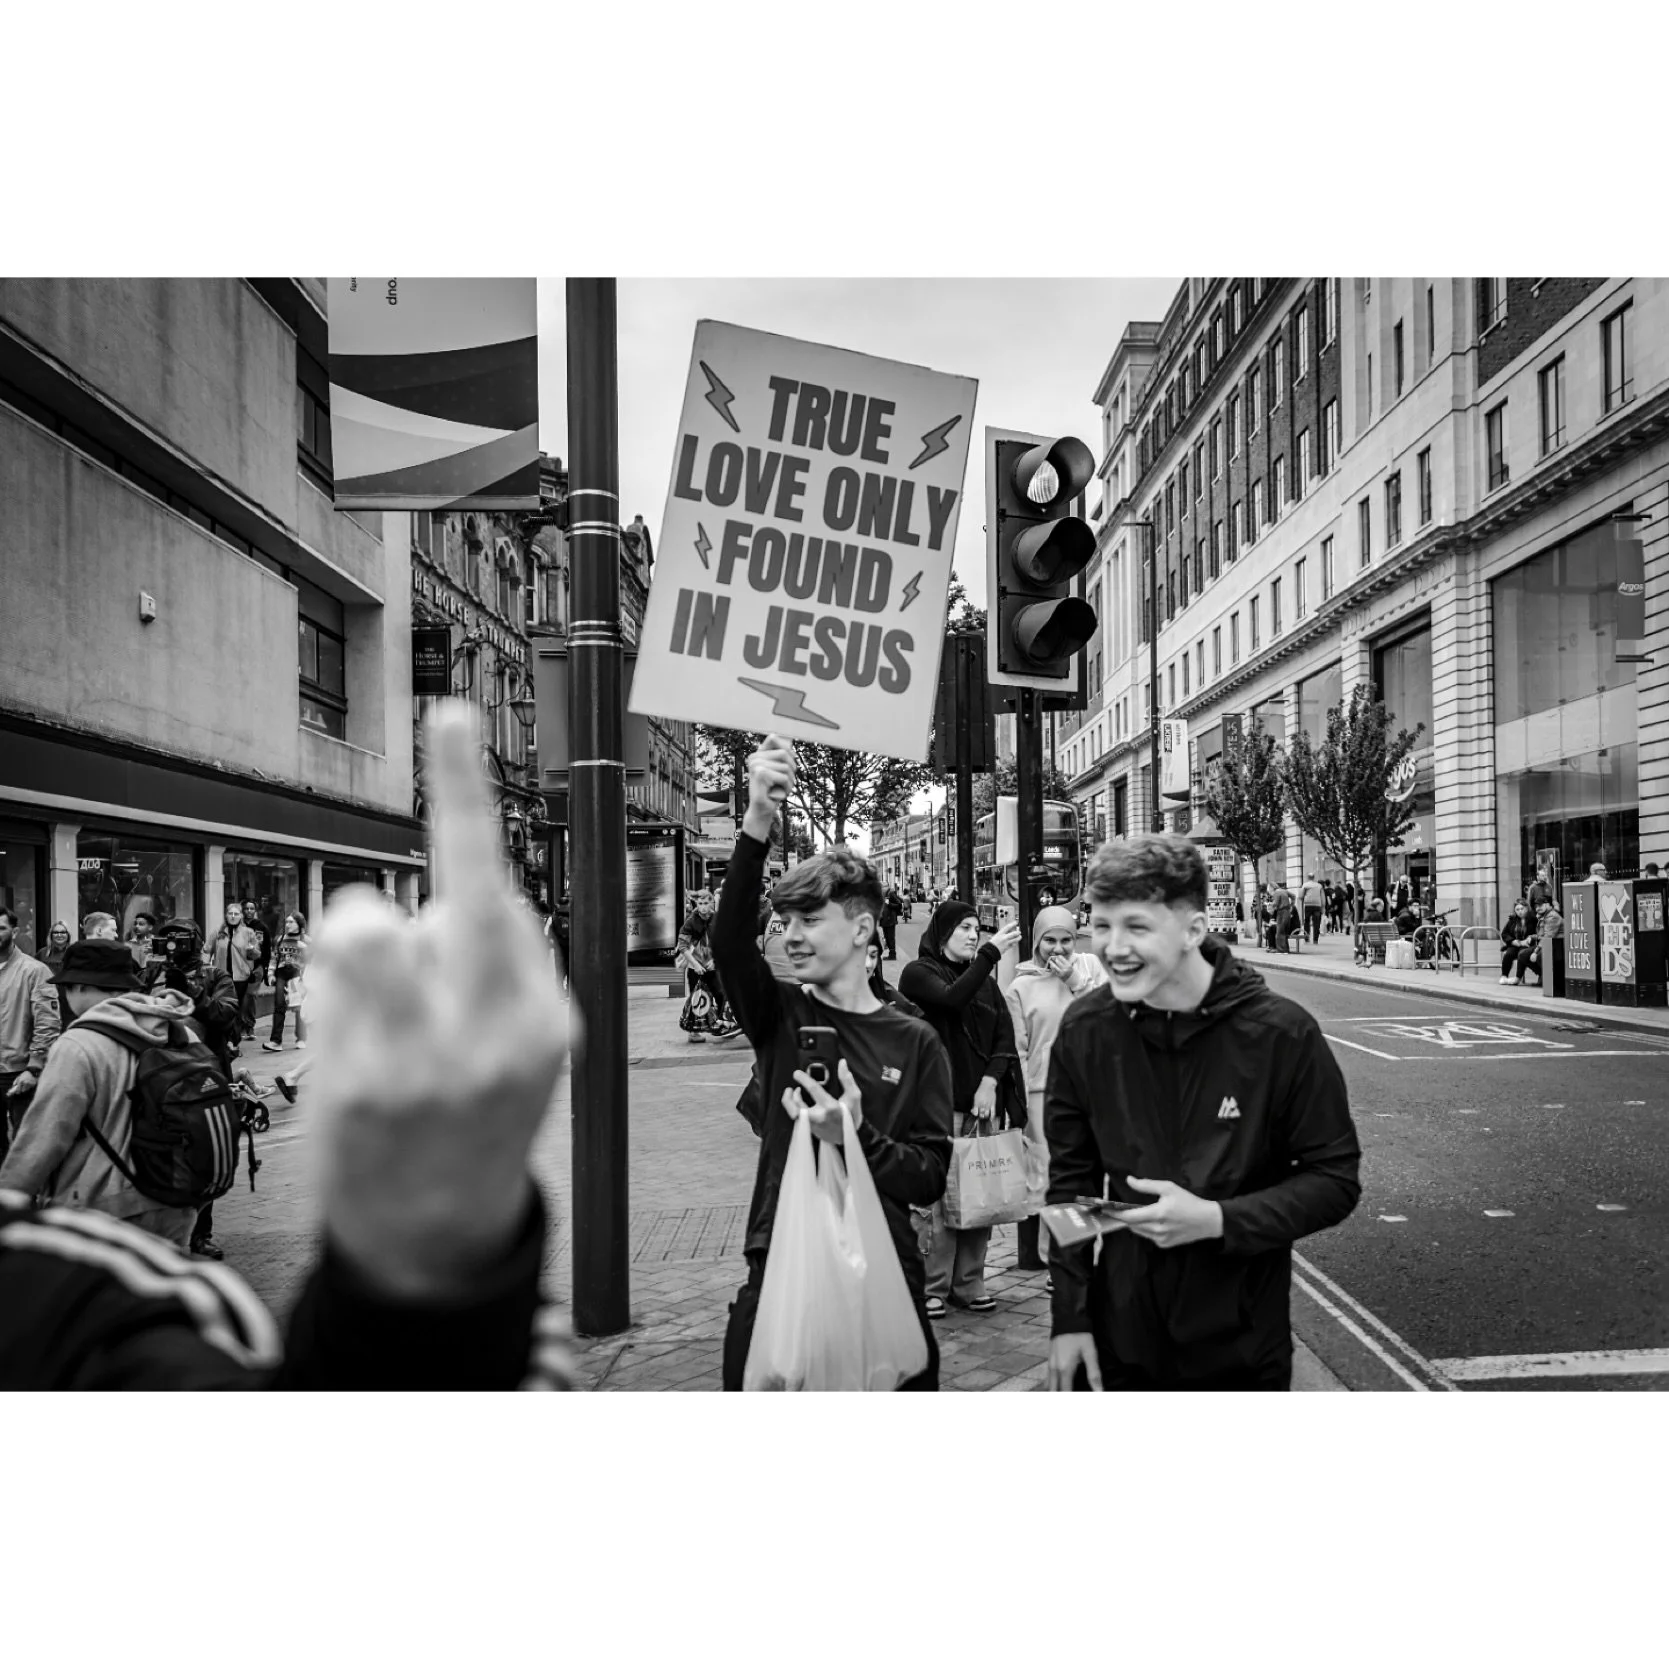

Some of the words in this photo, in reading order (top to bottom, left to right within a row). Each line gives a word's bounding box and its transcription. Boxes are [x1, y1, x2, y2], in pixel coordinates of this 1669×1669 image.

[385, 277, 397, 305] oup
[768, 375, 896, 465] TRUE
[674, 433, 811, 523] LOVE
[822, 466, 959, 552] ONLY
[716, 519, 893, 614] FOUND
[414, 569, 428, 597] HE
[435, 584, 468, 627] HORSE
[1618, 581, 1644, 592] Argos
[669, 588, 731, 662] IN
[743, 605, 914, 694] JESUS
[1387, 757, 1416, 790] gos
[1571, 894, 1583, 912] WE
[1571, 913, 1585, 931] ALL
[1569, 932, 1589, 950] LOVE
[1568, 951, 1591, 970] LEEDS
[968, 1157, 1013, 1171] PRIMRK
